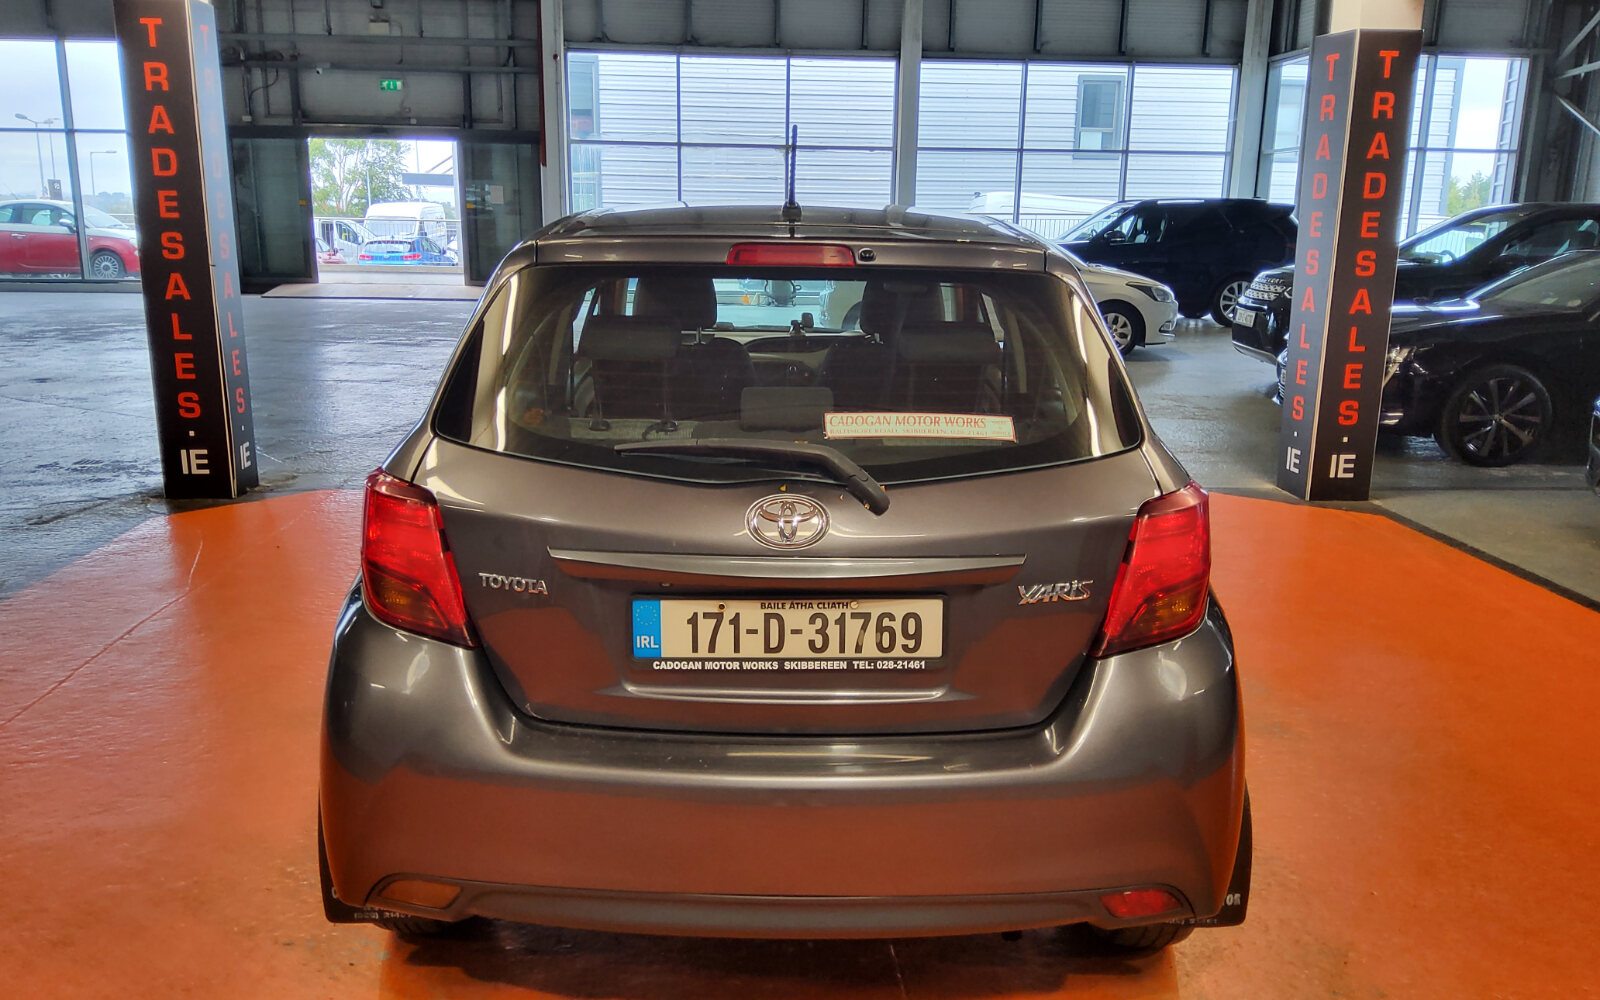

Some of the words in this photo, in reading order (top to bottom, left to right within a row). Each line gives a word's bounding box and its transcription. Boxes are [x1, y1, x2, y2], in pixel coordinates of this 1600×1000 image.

[829, 415, 892, 427] CADOGAN
[895, 415, 941, 427] MOTOR
[943, 416, 987, 429] WORKS
[478, 572, 548, 595] TOYOTA
[760, 601, 787, 610] BAILE
[788, 600, 814, 610] ÁTHA
[816, 601, 849, 610] CLIATH
[686, 612, 923, 654] 171-D-31769
[636, 635, 659, 649] IRL
[653, 661, 702, 670] CADOGAN
[704, 661, 740, 670] MOTOR
[742, 661, 779, 670] WORKS
[784, 661, 848, 670] SKIBBEREEN
[853, 661, 875, 670] TEL:
[876, 660, 926, 670] 028-21461
